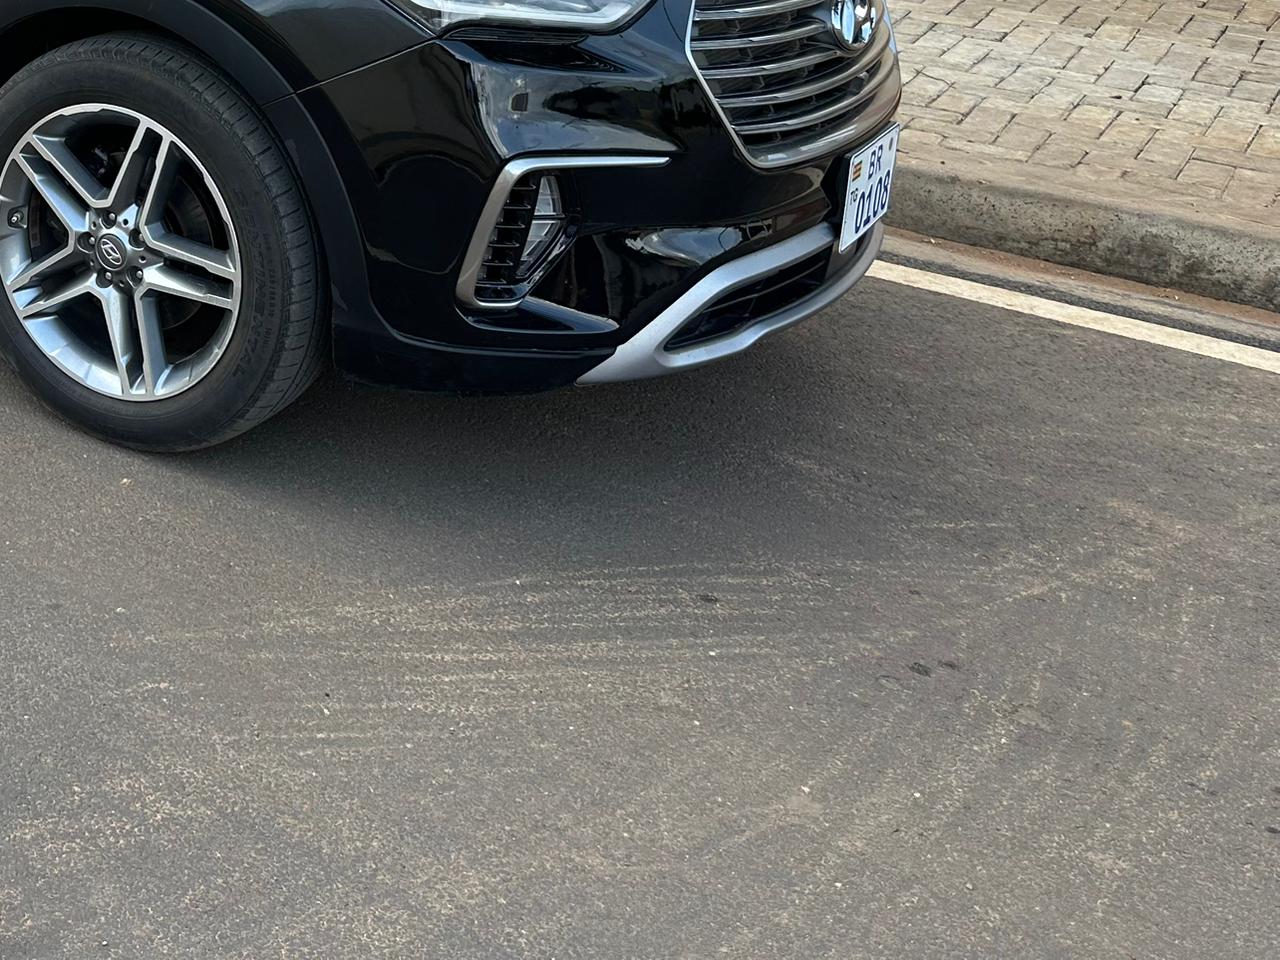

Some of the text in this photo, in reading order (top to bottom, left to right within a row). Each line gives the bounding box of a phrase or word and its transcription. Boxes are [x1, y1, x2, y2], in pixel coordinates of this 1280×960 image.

[867, 144, 884, 181] BR
[850, 188, 859, 206] TG
[854, 169, 891, 234] 0108
